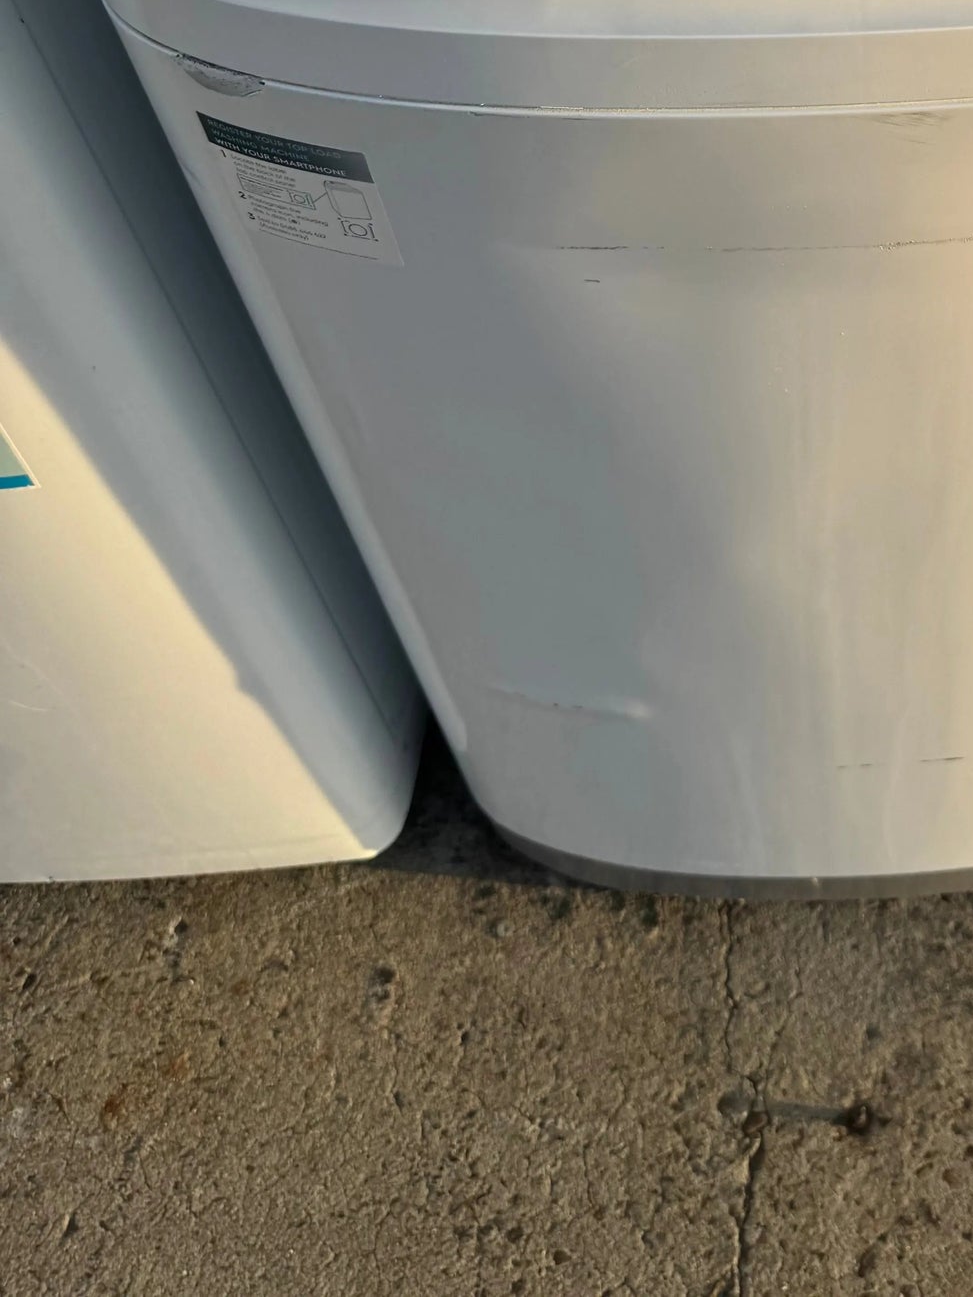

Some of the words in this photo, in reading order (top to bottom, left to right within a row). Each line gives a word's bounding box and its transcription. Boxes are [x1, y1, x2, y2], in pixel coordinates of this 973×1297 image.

[207, 119, 252, 139] REGISTER
[255, 134, 284, 148] YOUR
[287, 142, 308, 153] TOP
[311, 148, 342, 160] LOAD
[212, 129, 258, 150] WASHING
[260, 145, 310, 162] MACHINE
[215, 137, 242, 154] WITH
[243, 148, 271, 163] YOUR
[273, 156, 347, 177] SMARTPHONE
[238, 191, 247, 199] 2
[248, 212, 256, 220] 3
